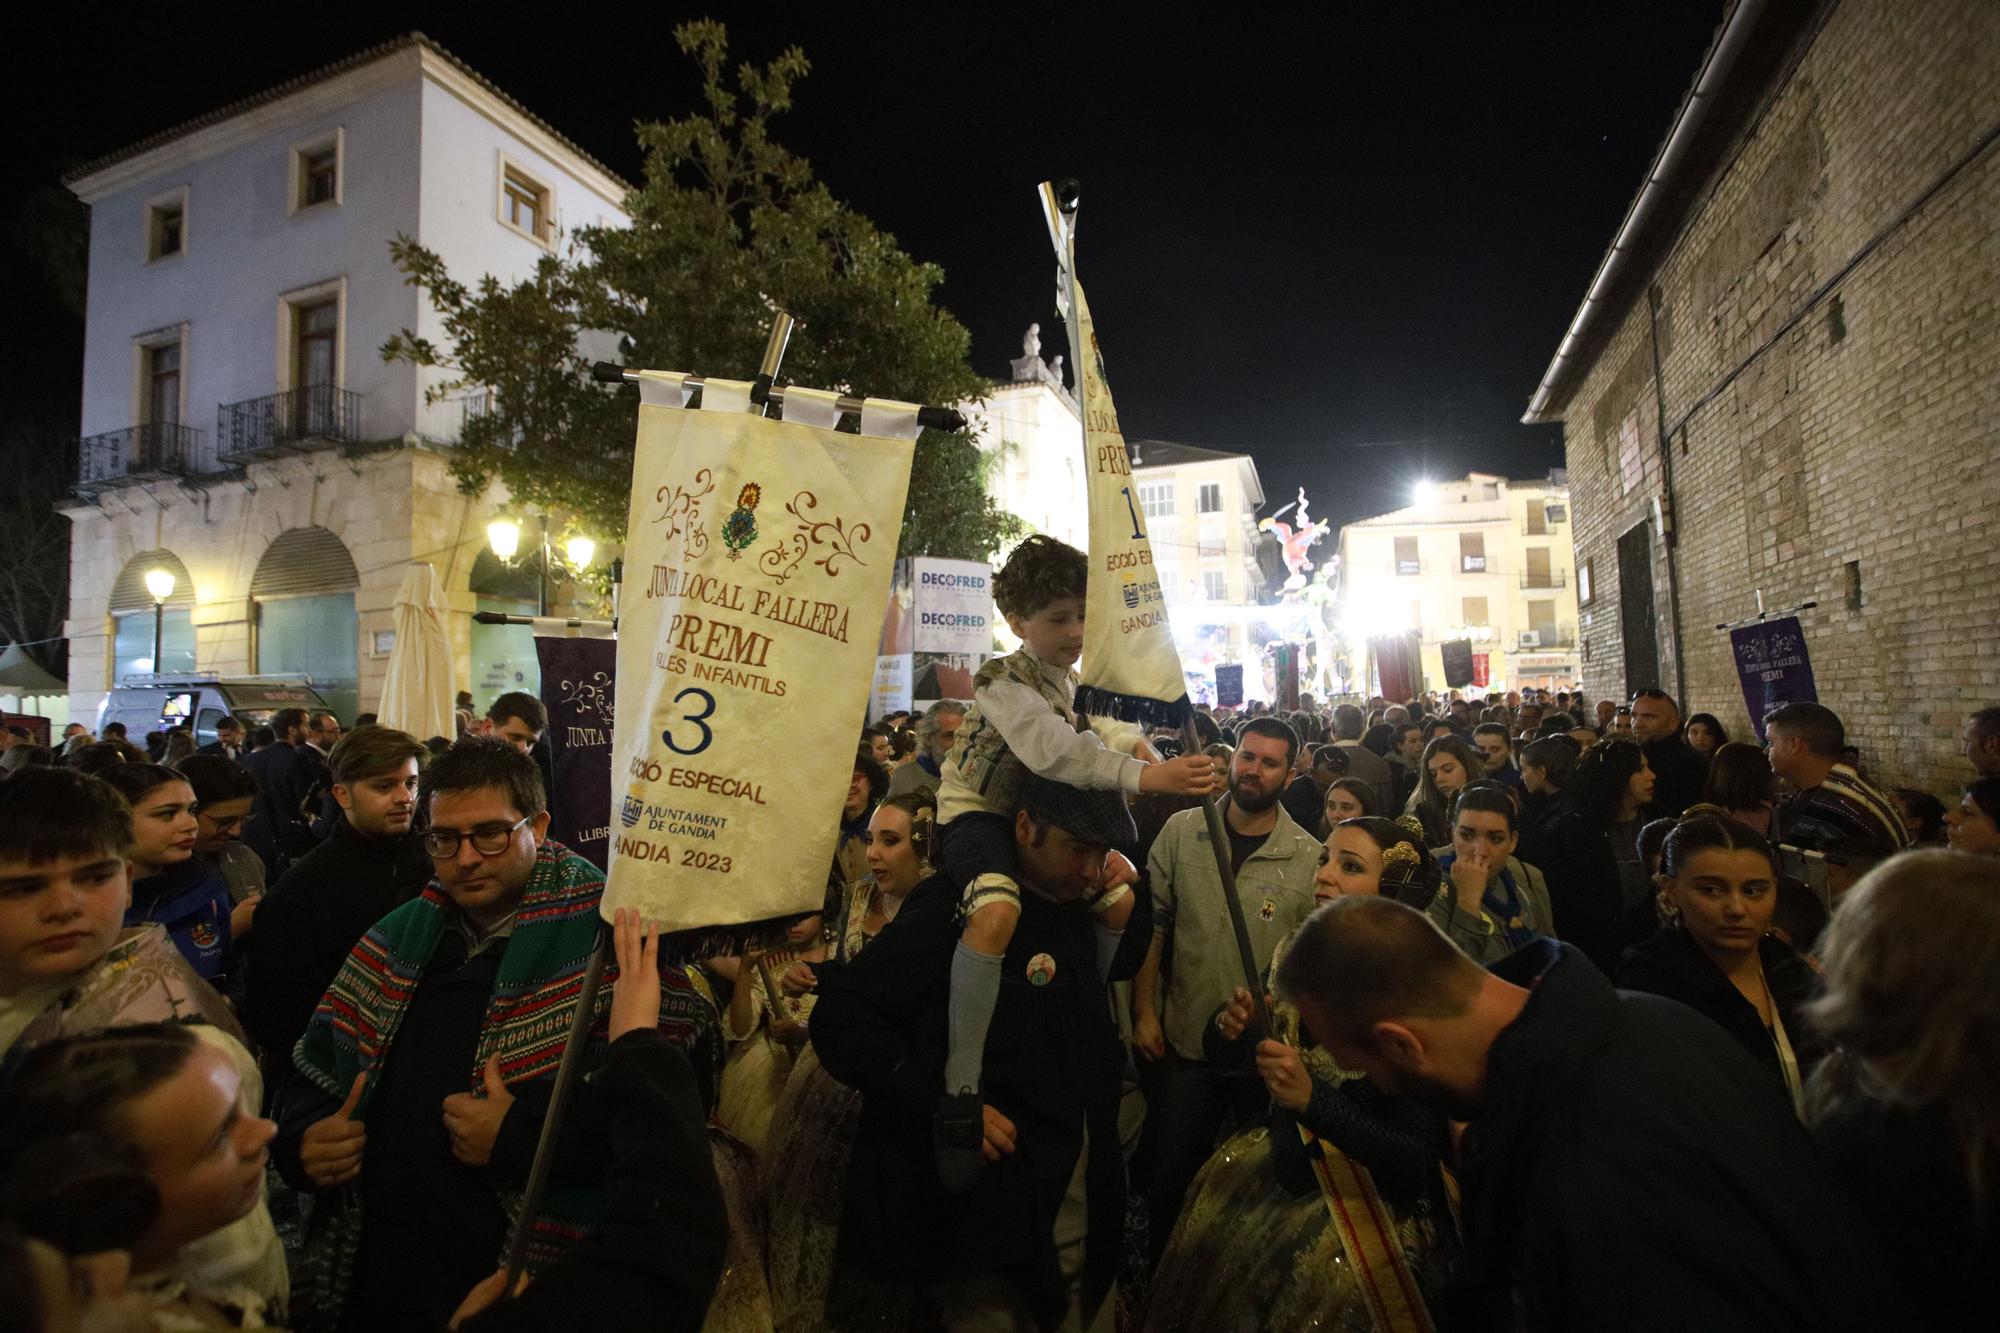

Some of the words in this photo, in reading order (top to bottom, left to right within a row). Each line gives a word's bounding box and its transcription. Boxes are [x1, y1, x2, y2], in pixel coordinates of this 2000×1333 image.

[1121, 487, 1146, 539] 1
[921, 572, 985, 588] DECOFRED
[679, 572, 744, 611] LOCAL
[751, 590, 849, 643] FALLERA
[921, 612, 985, 627] DECOFRED
[666, 614, 774, 667] PREMI
[693, 662, 786, 696] INFANTILS
[662, 687, 716, 756] 3
[566, 727, 607, 748] JUNTA
[669, 768, 766, 805] ESPECIAL
[644, 806, 728, 829] AJUNTAMENT
[648, 819, 665, 832] DE
[668, 823, 716, 840] GANDIA
[681, 849, 732, 873] 2023
